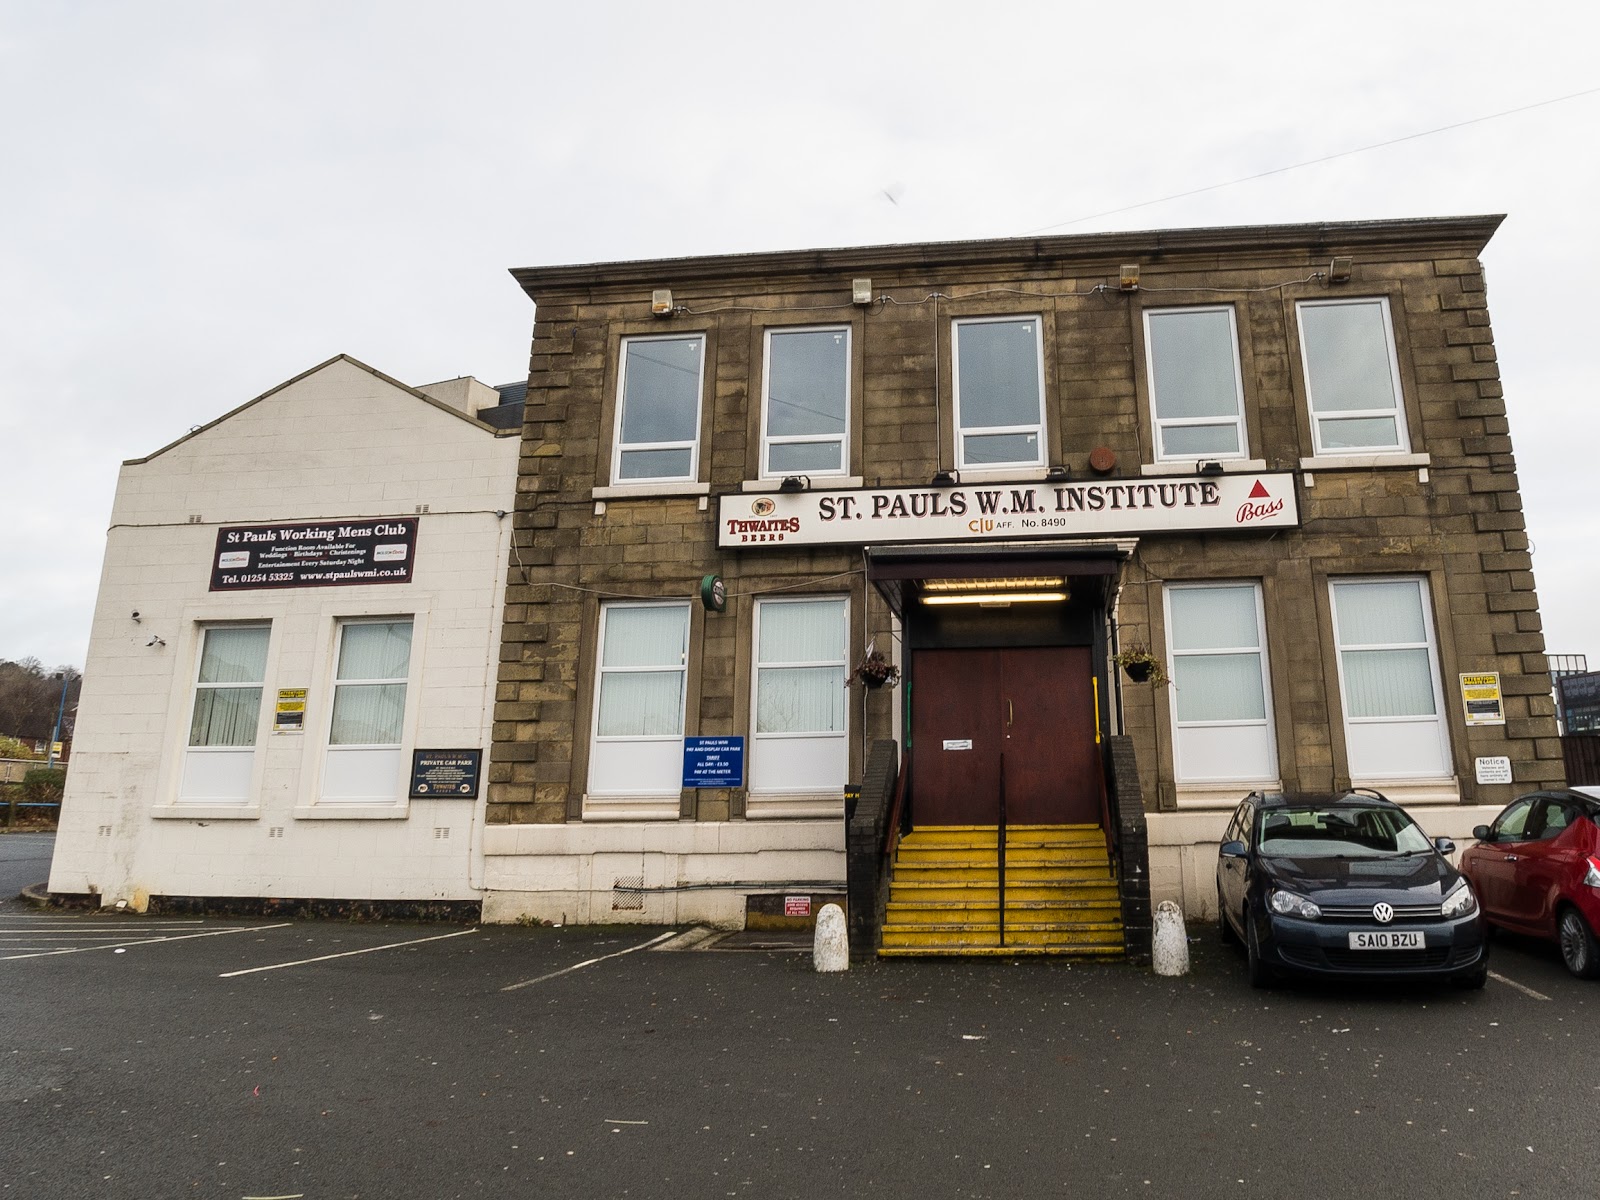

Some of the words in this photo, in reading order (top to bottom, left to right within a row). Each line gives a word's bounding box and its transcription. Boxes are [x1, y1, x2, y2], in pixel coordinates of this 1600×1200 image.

[819, 496, 862, 522] ST.
[871, 491, 968, 520] PAULS
[975, 489, 1045, 516] W.M.
[1053, 481, 1222, 513] INSTITUTE
[1236, 498, 1284, 523] Bass
[727, 517, 800, 535] THWAITES
[1041, 518, 1066, 527] 8490
[226, 531, 240, 543] St
[242, 530, 277, 542] Pauls
[279, 526, 336, 541] Working
[337, 526, 372, 538] Mens
[374, 523, 406, 536] Club
[741, 533, 784, 543] BEERS
[294, 550, 323, 558] Birthdays
[257, 561, 301, 569] Entertainment
[301, 560, 319, 568] Every
[319, 559, 347, 567] Saturday
[347, 558, 365, 566] Night
[221, 575, 239, 584] Tel.
[241, 573, 267, 583] 01254
[268, 572, 294, 582] 53325
[300, 567, 407, 581] www.stpaulswmi.co.uk
[1357, 934, 1388, 947] SA10
[1391, 934, 1418, 947] BZU
